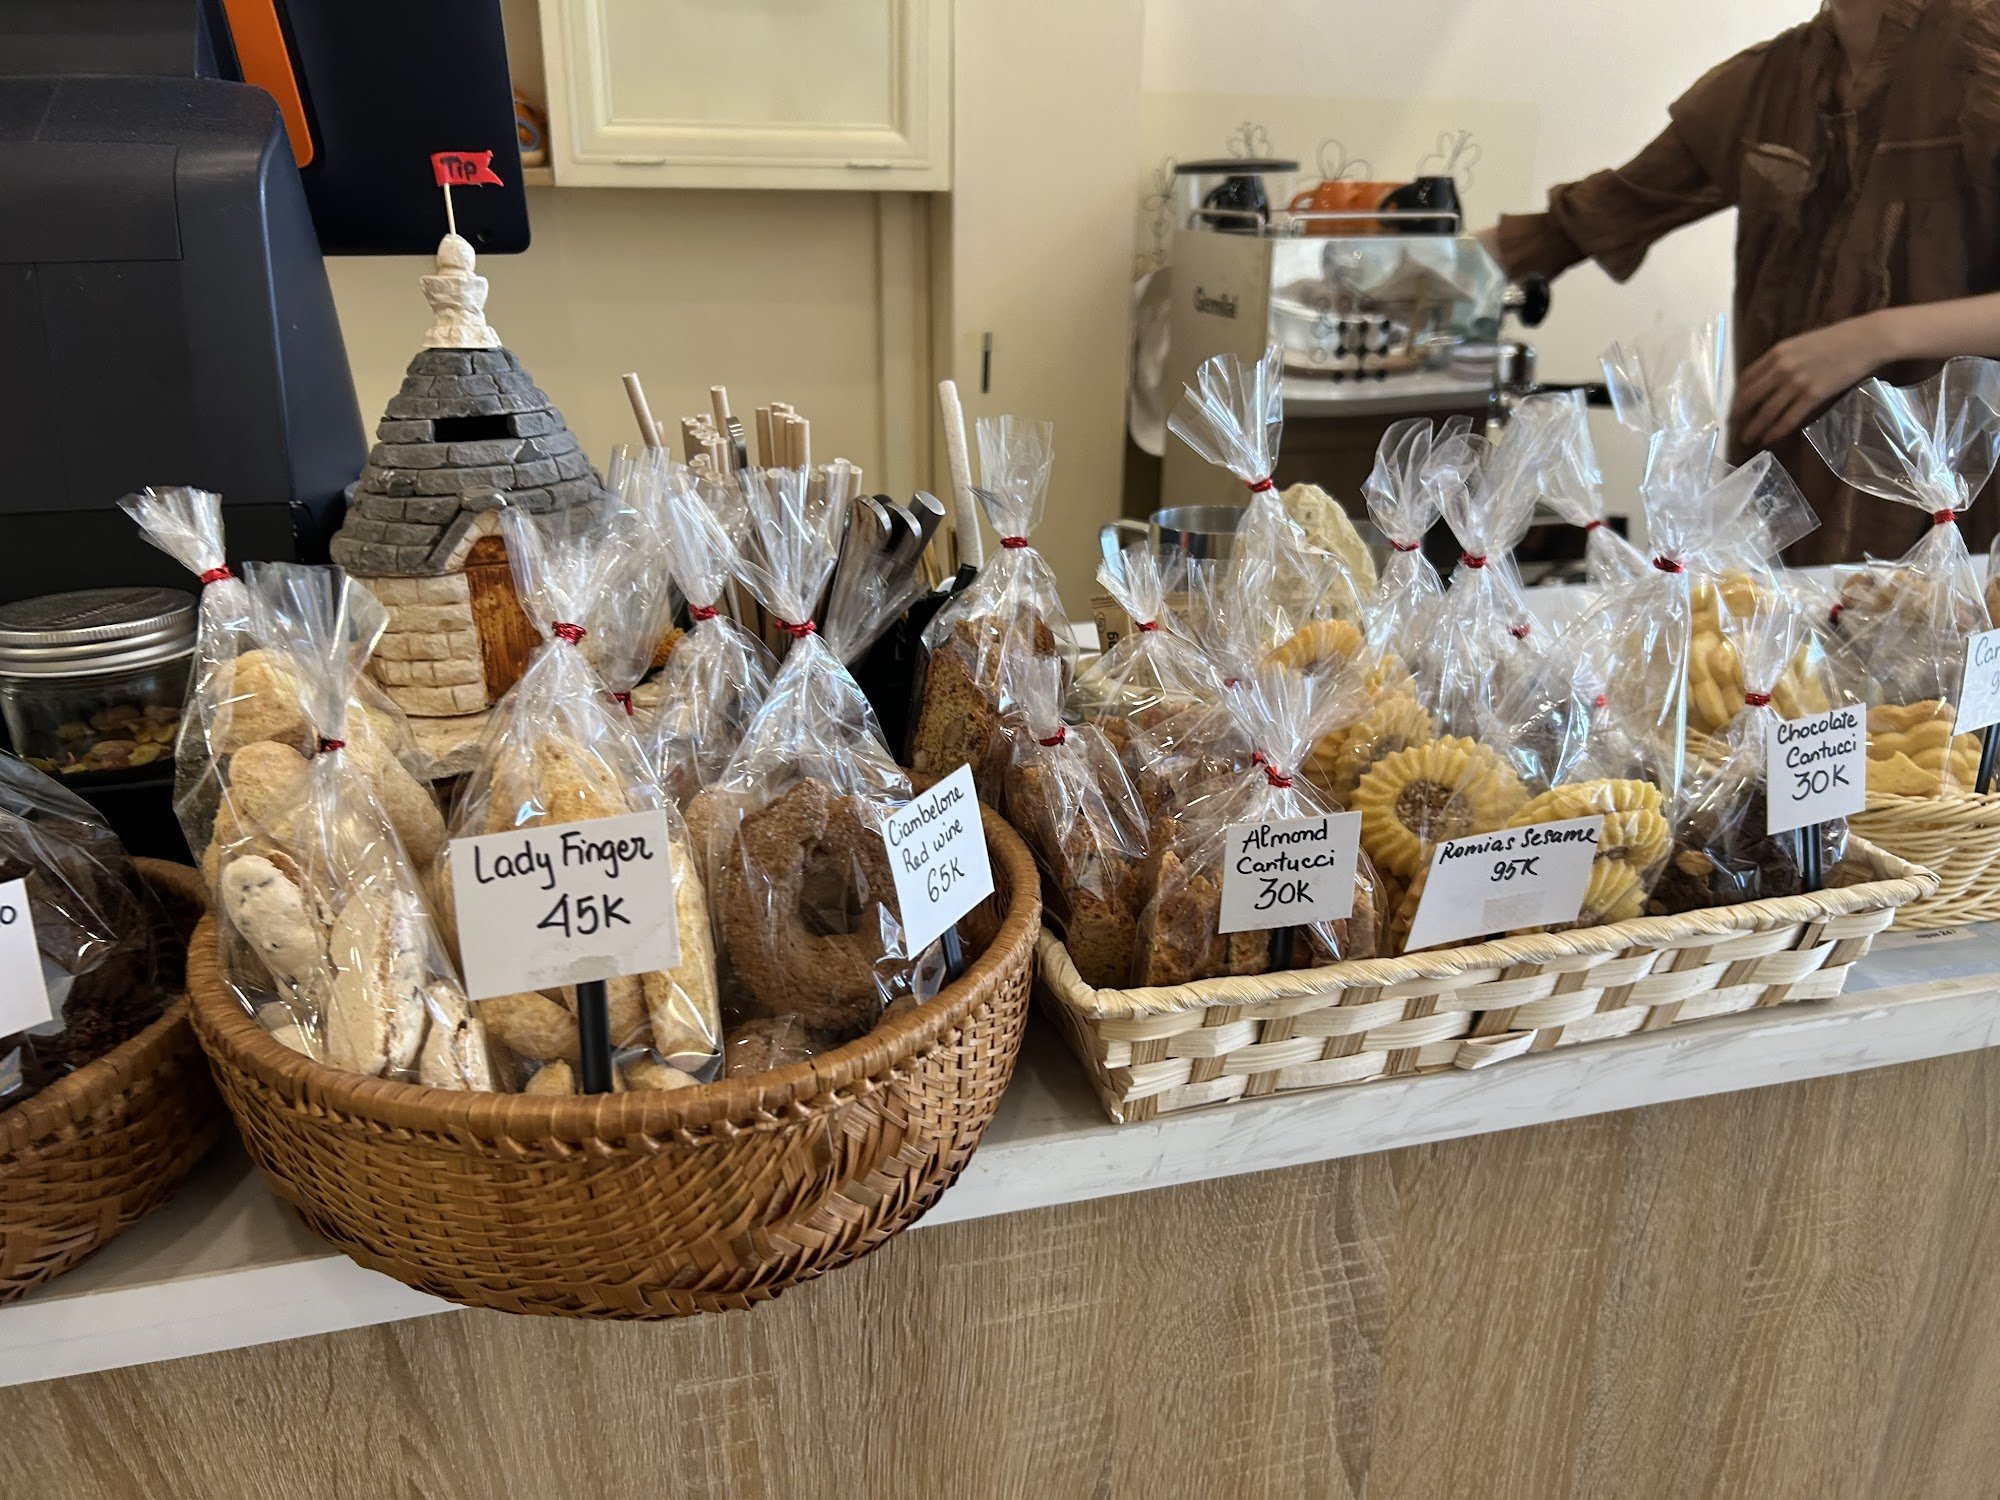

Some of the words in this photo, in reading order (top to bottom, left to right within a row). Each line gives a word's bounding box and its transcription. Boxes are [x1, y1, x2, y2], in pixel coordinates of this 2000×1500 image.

[1777, 711, 1858, 745] Chocolate
[1786, 733, 1857, 768] Cantucci
[1792, 764, 1850, 801] 30K
[888, 786, 965, 847] Ciambelone
[902, 841, 930, 873] Red
[933, 818, 964, 852] wine
[1242, 818, 1328, 853] Almond
[1438, 836, 1516, 865] Romias
[1520, 827, 1599, 848] Sesame
[474, 839, 556, 890] Lady
[560, 831, 654, 878] Finger
[1236, 849, 1335, 874] Cantucci
[1490, 856, 1540, 881] 95K
[927, 857, 965, 903] 65K
[1254, 877, 1315, 910] 30K
[536, 893, 631, 938] 45K
